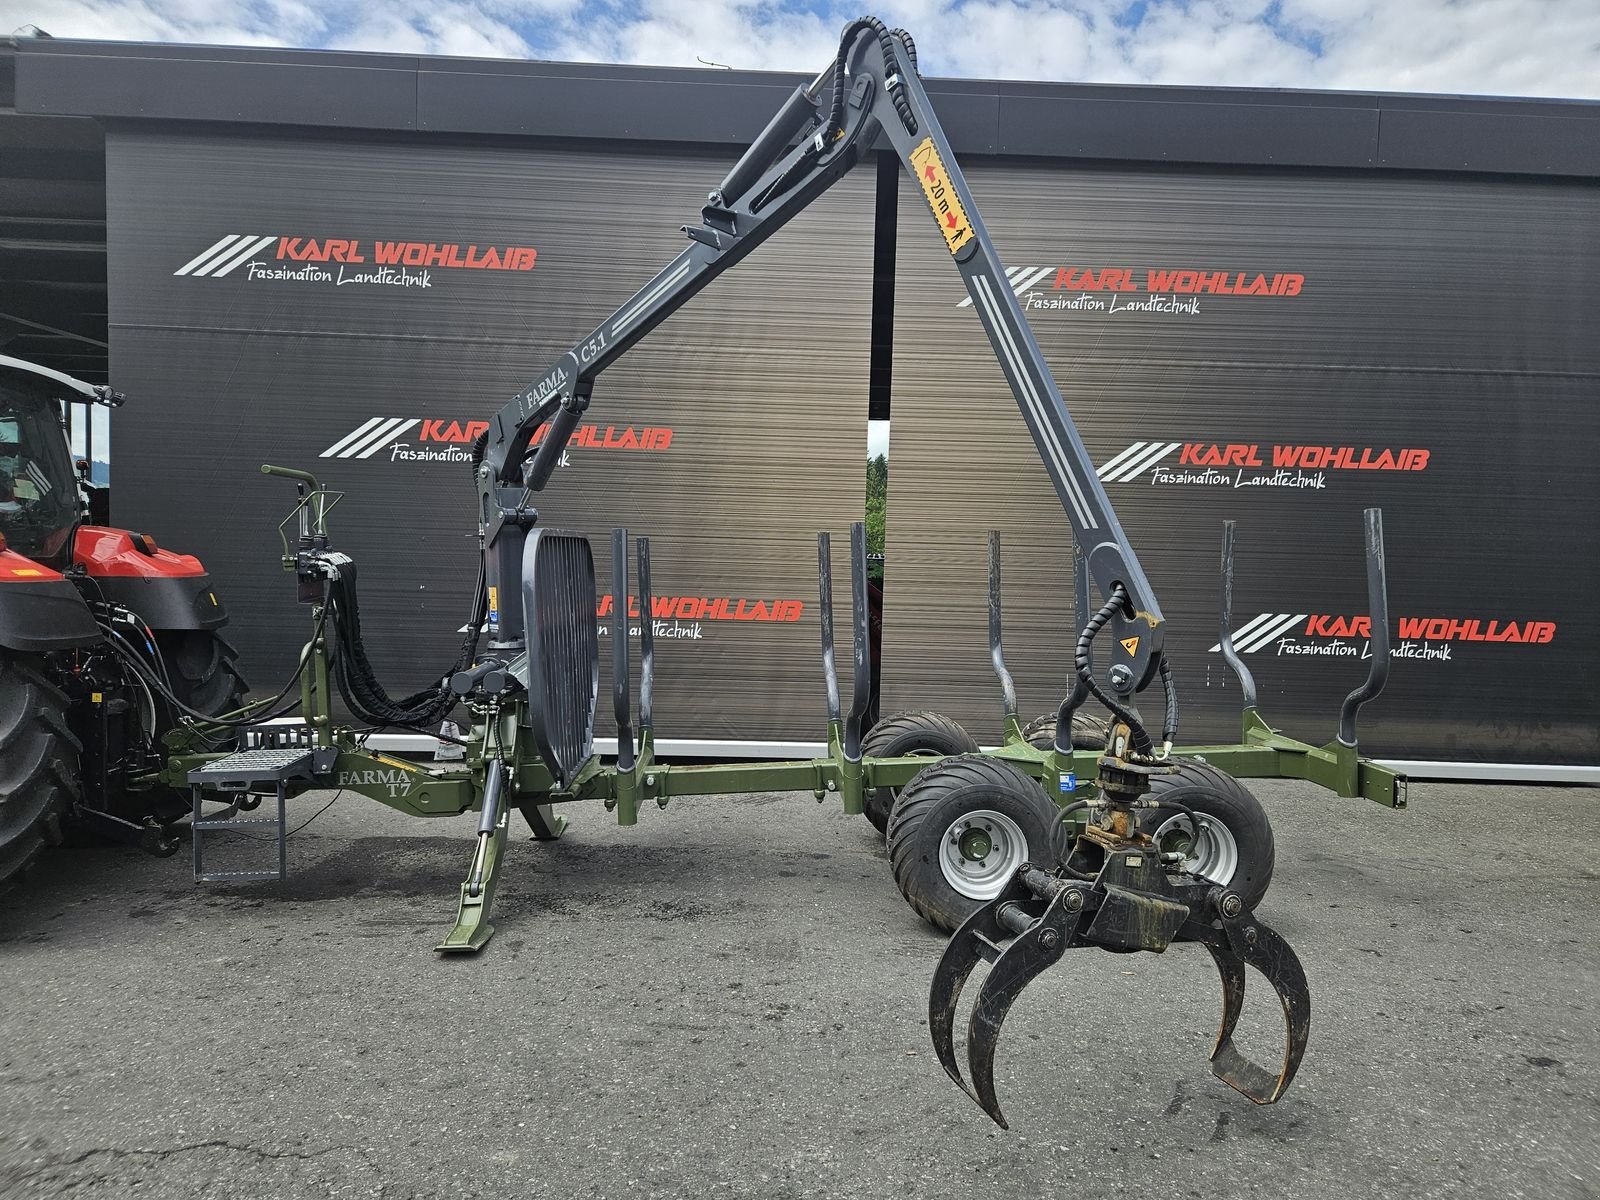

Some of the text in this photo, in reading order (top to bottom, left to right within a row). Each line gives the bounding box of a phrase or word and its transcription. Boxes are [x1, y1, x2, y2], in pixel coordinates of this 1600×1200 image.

[930, 179, 950, 215] 20 m
[276, 236, 364, 263] KARL
[246, 260, 432, 289] Faszination Landtechnik
[1053, 267, 1137, 292] KARL
[1024, 291, 1201, 315] Faszination Landtechnik
[581, 331, 607, 363] C5.1
[526, 367, 567, 410] FARMA
[419, 419, 490, 443] KAR
[389, 442, 473, 463] Faszination
[1179, 443, 1263, 467] KARL
[1151, 466, 1326, 489] Faszination Landtechnik
[1304, 614, 1372, 638] KAR
[1276, 637, 1453, 661] Faszination Lndtechnik
[338, 769, 411, 786] FARMA
[386, 783, 412, 798] T7
